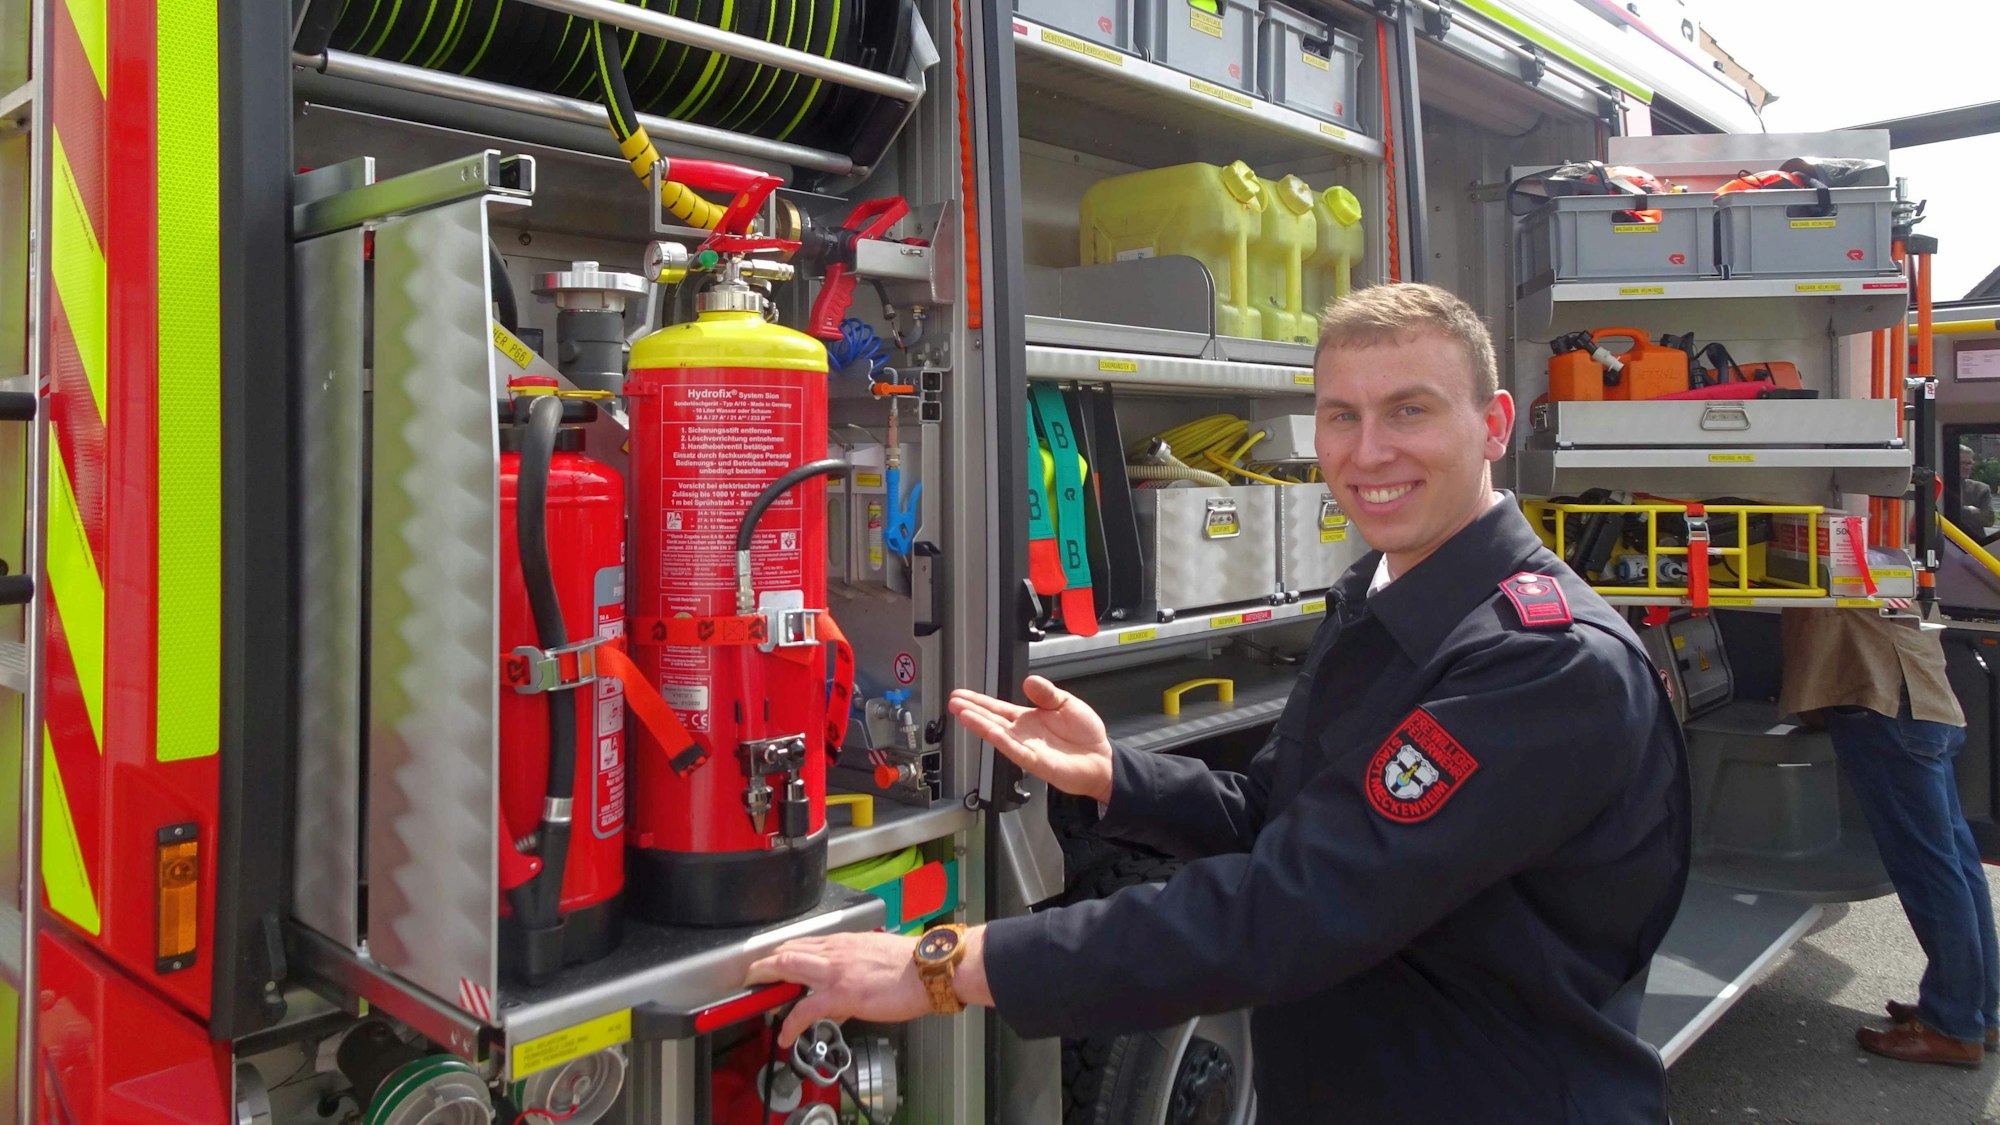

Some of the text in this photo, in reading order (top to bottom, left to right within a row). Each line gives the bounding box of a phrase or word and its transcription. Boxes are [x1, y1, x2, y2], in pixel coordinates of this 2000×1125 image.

[509, 344, 527, 361] PG6
[739, 392, 763, 400] System
[1052, 422, 1069, 449] B
[676, 460, 716, 468] Bedienungs-
[718, 452, 763, 460] fachkundiges
[1066, 540, 1081, 569] B
[1371, 737, 1403, 775] STADT
[1403, 722, 1463, 780] FEUERWEHR
[1412, 715, 1473, 772] FREIWILLIGE
[1371, 778, 1450, 816] MECKENHEIM
